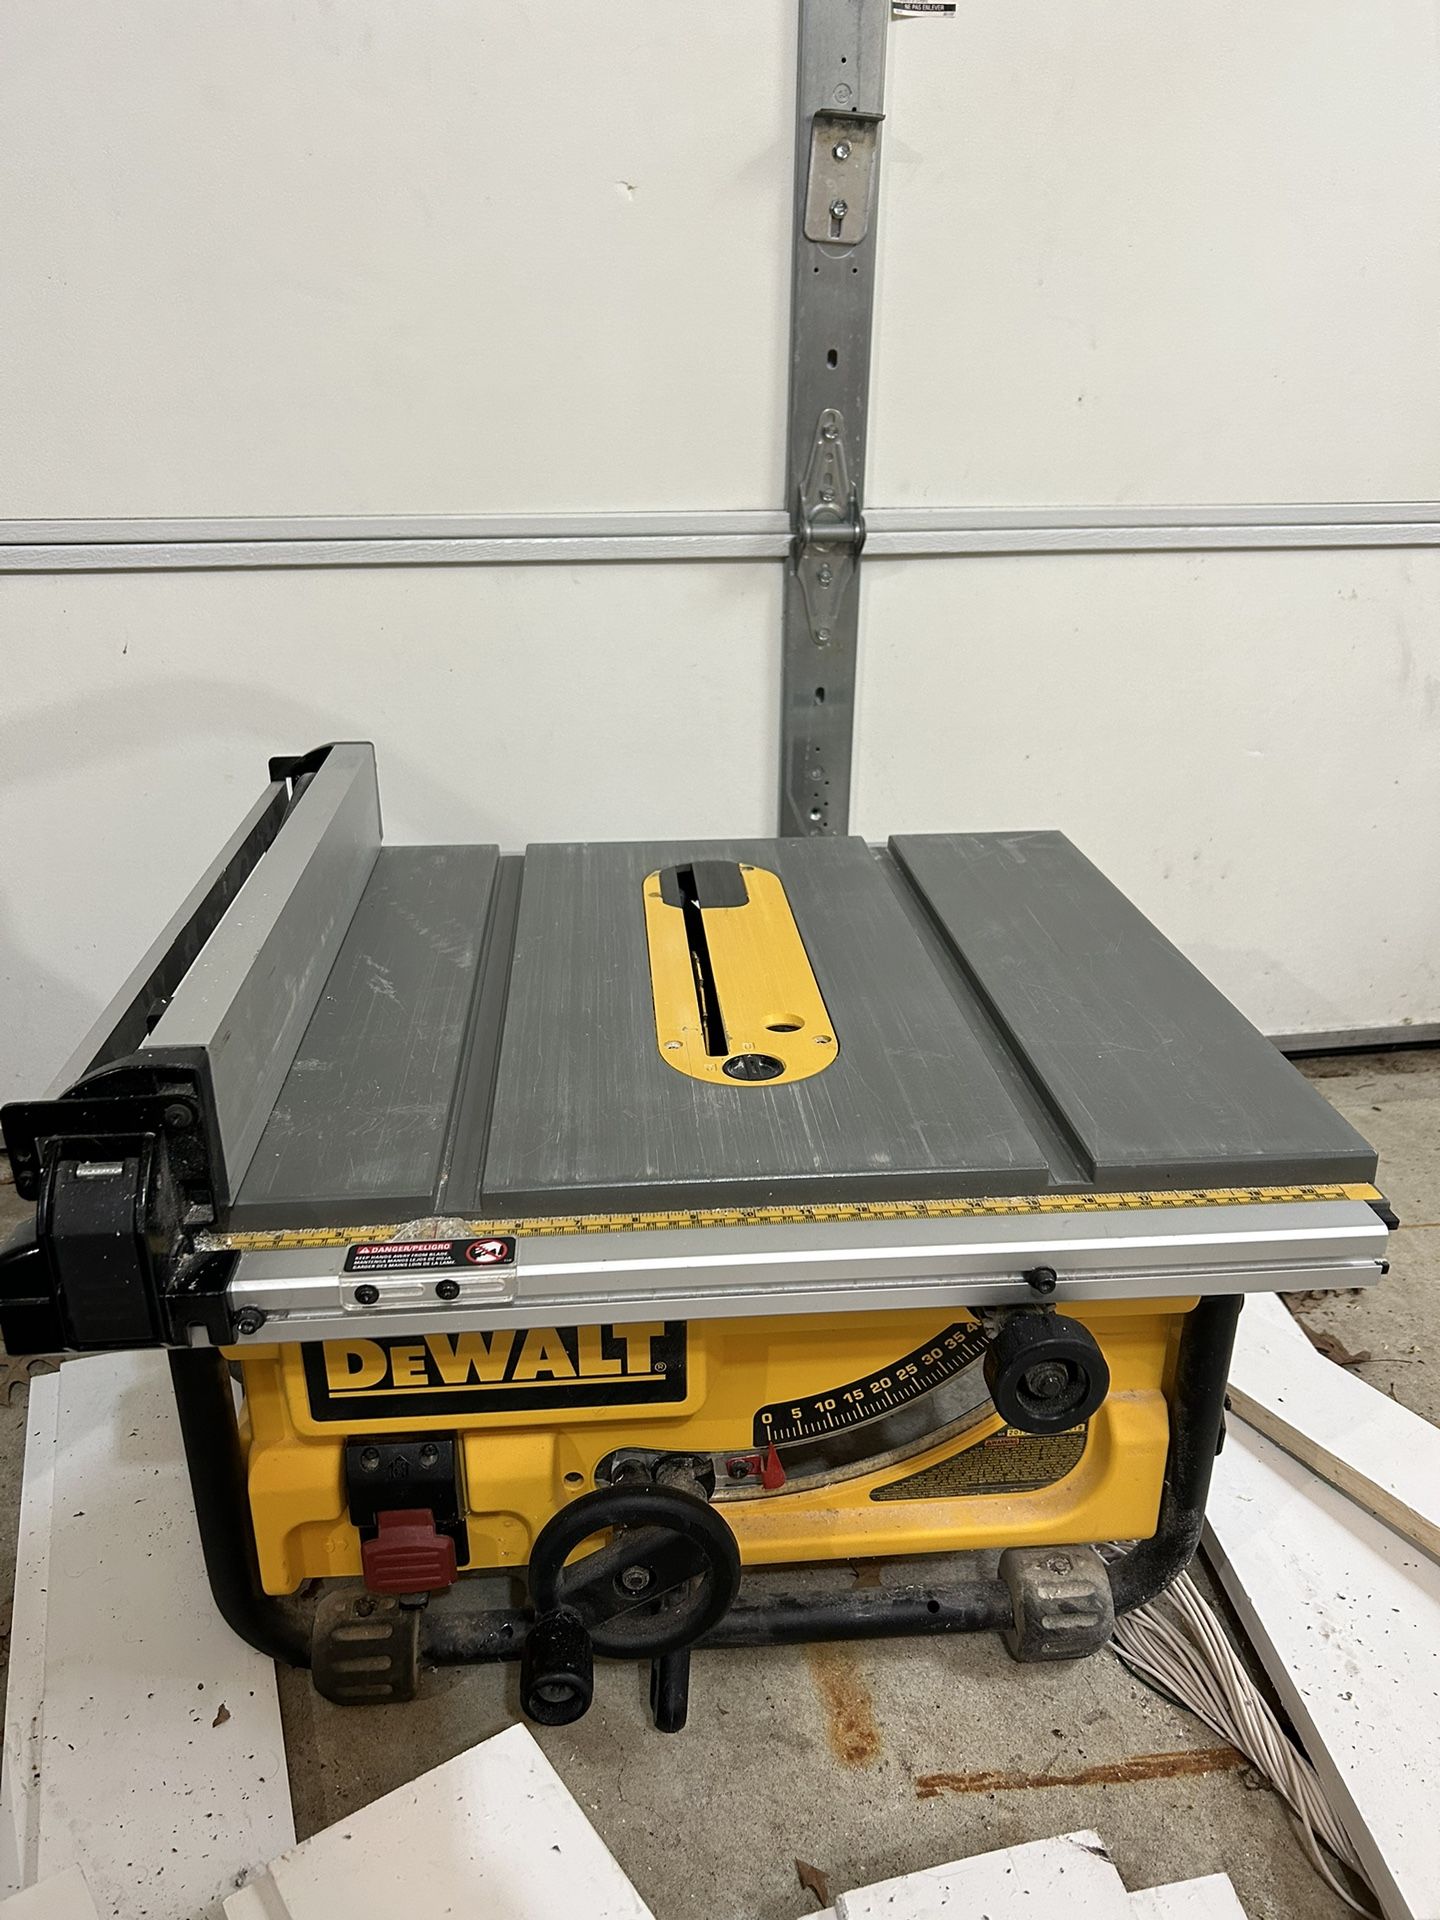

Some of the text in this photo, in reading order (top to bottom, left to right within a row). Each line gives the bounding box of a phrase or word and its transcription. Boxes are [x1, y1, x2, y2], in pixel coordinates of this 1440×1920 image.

[370, 1244, 450, 1254] DANGER/PELIGRO
[761, 1320, 982, 1424] 0 5 10 15 20 25 30 35 4
